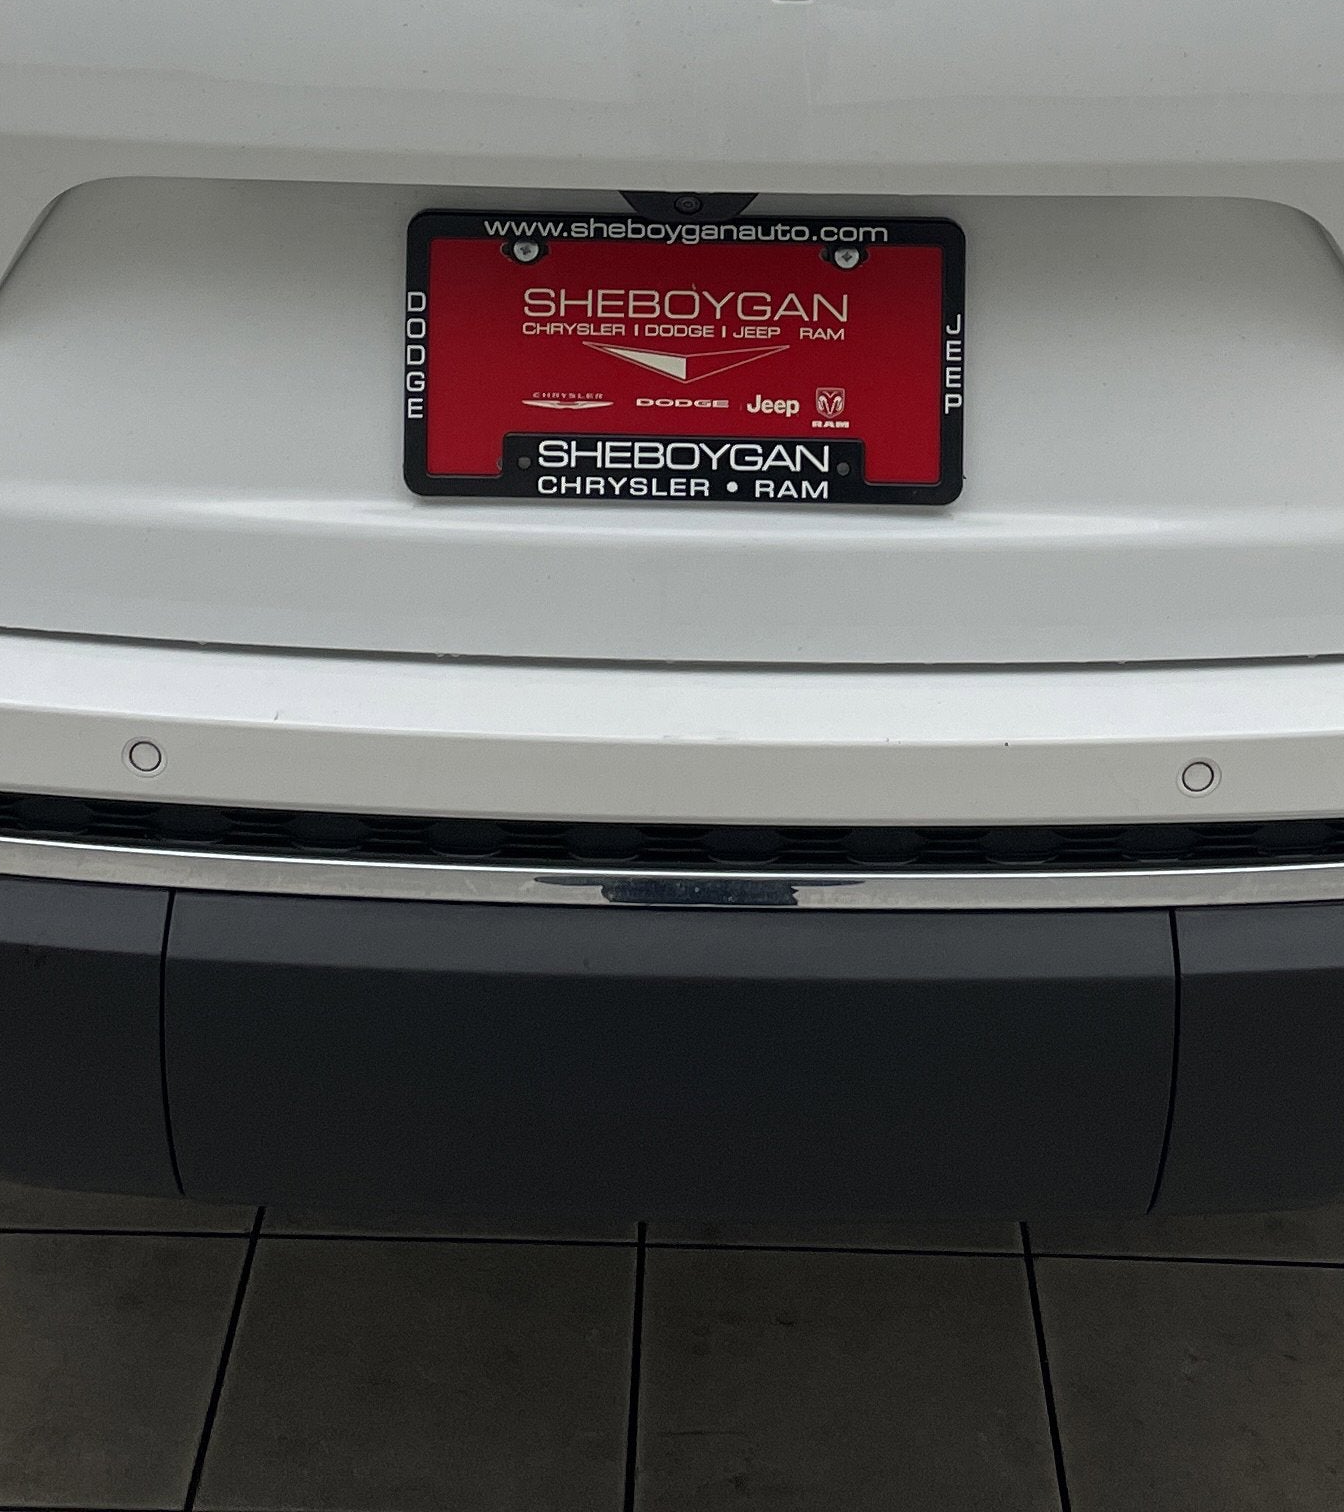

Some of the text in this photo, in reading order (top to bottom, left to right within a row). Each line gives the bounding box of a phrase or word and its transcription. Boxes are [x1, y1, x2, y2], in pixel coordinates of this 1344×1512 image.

[483, 217, 889, 245] www.sheboyganauto.com
[523, 288, 849, 323] SHEBOYGAN
[522, 322, 845, 341] CHRYSLER DODGE JEEP RAM
[406, 291, 427, 419] DODGE
[944, 313, 962, 415] JEEP
[636, 398, 730, 409] DODGE
[747, 394, 801, 417] Jeep
[812, 420, 850, 429] RAM
[538, 440, 830, 473] SHEBOYGAN
[537, 475, 830, 500] CHRYSLER RAM
